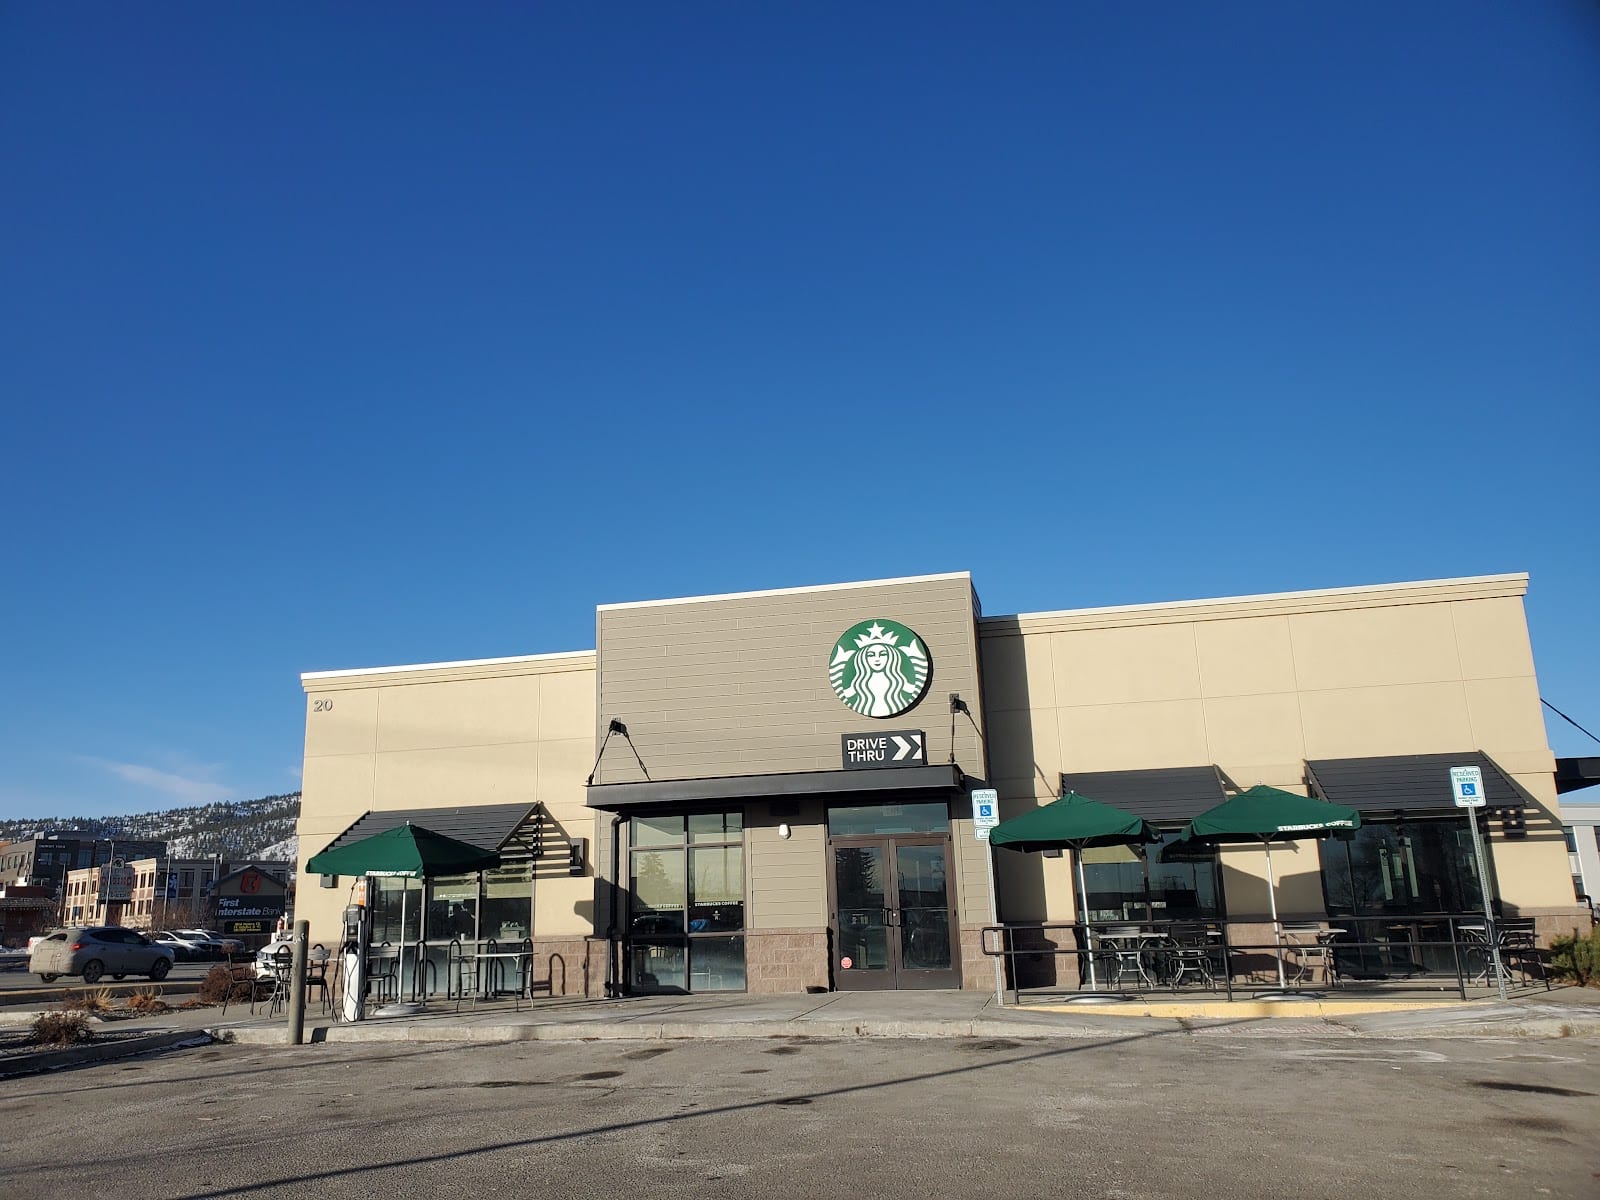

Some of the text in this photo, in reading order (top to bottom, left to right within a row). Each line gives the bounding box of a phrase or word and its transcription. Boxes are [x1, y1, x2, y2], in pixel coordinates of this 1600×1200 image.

[313, 699, 333, 712] 20
[847, 738, 887, 750] DRIVE
[848, 750, 885, 762] THRU
[1277, 823, 1324, 831] STARBUCKS
[218, 899, 240, 907] First
[215, 906, 282, 916] Interstate Bank
